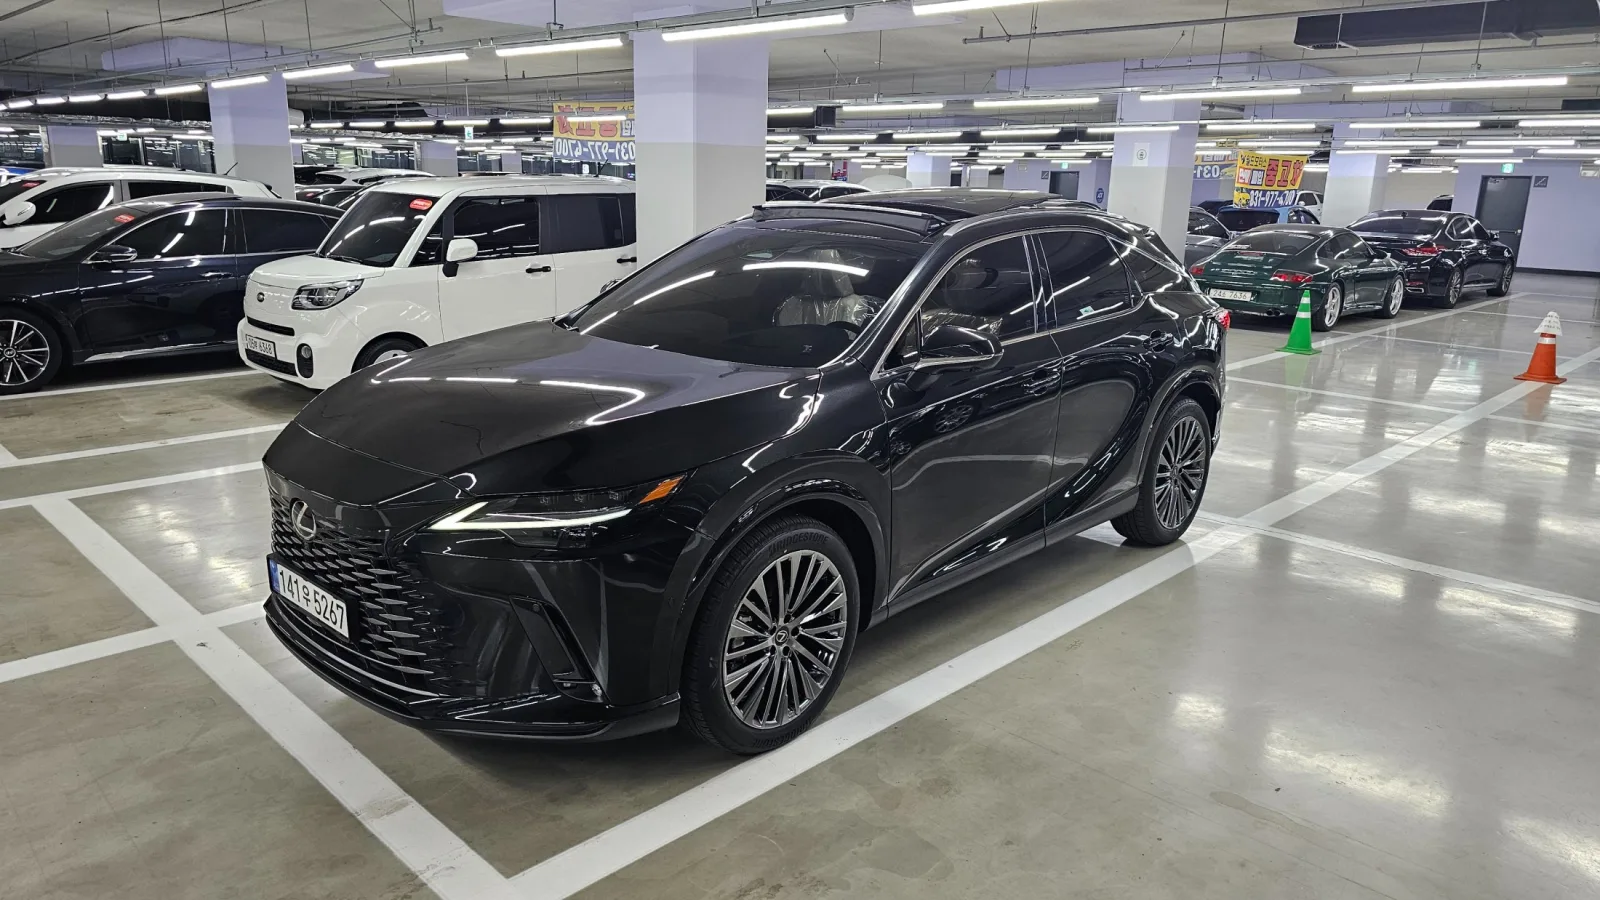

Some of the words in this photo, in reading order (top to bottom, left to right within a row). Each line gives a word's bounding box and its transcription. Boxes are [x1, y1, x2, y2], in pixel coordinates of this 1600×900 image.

[1265, 158, 1304, 187] 중고차
[279, 569, 311, 607] 141우
[313, 588, 345, 630] 5267
